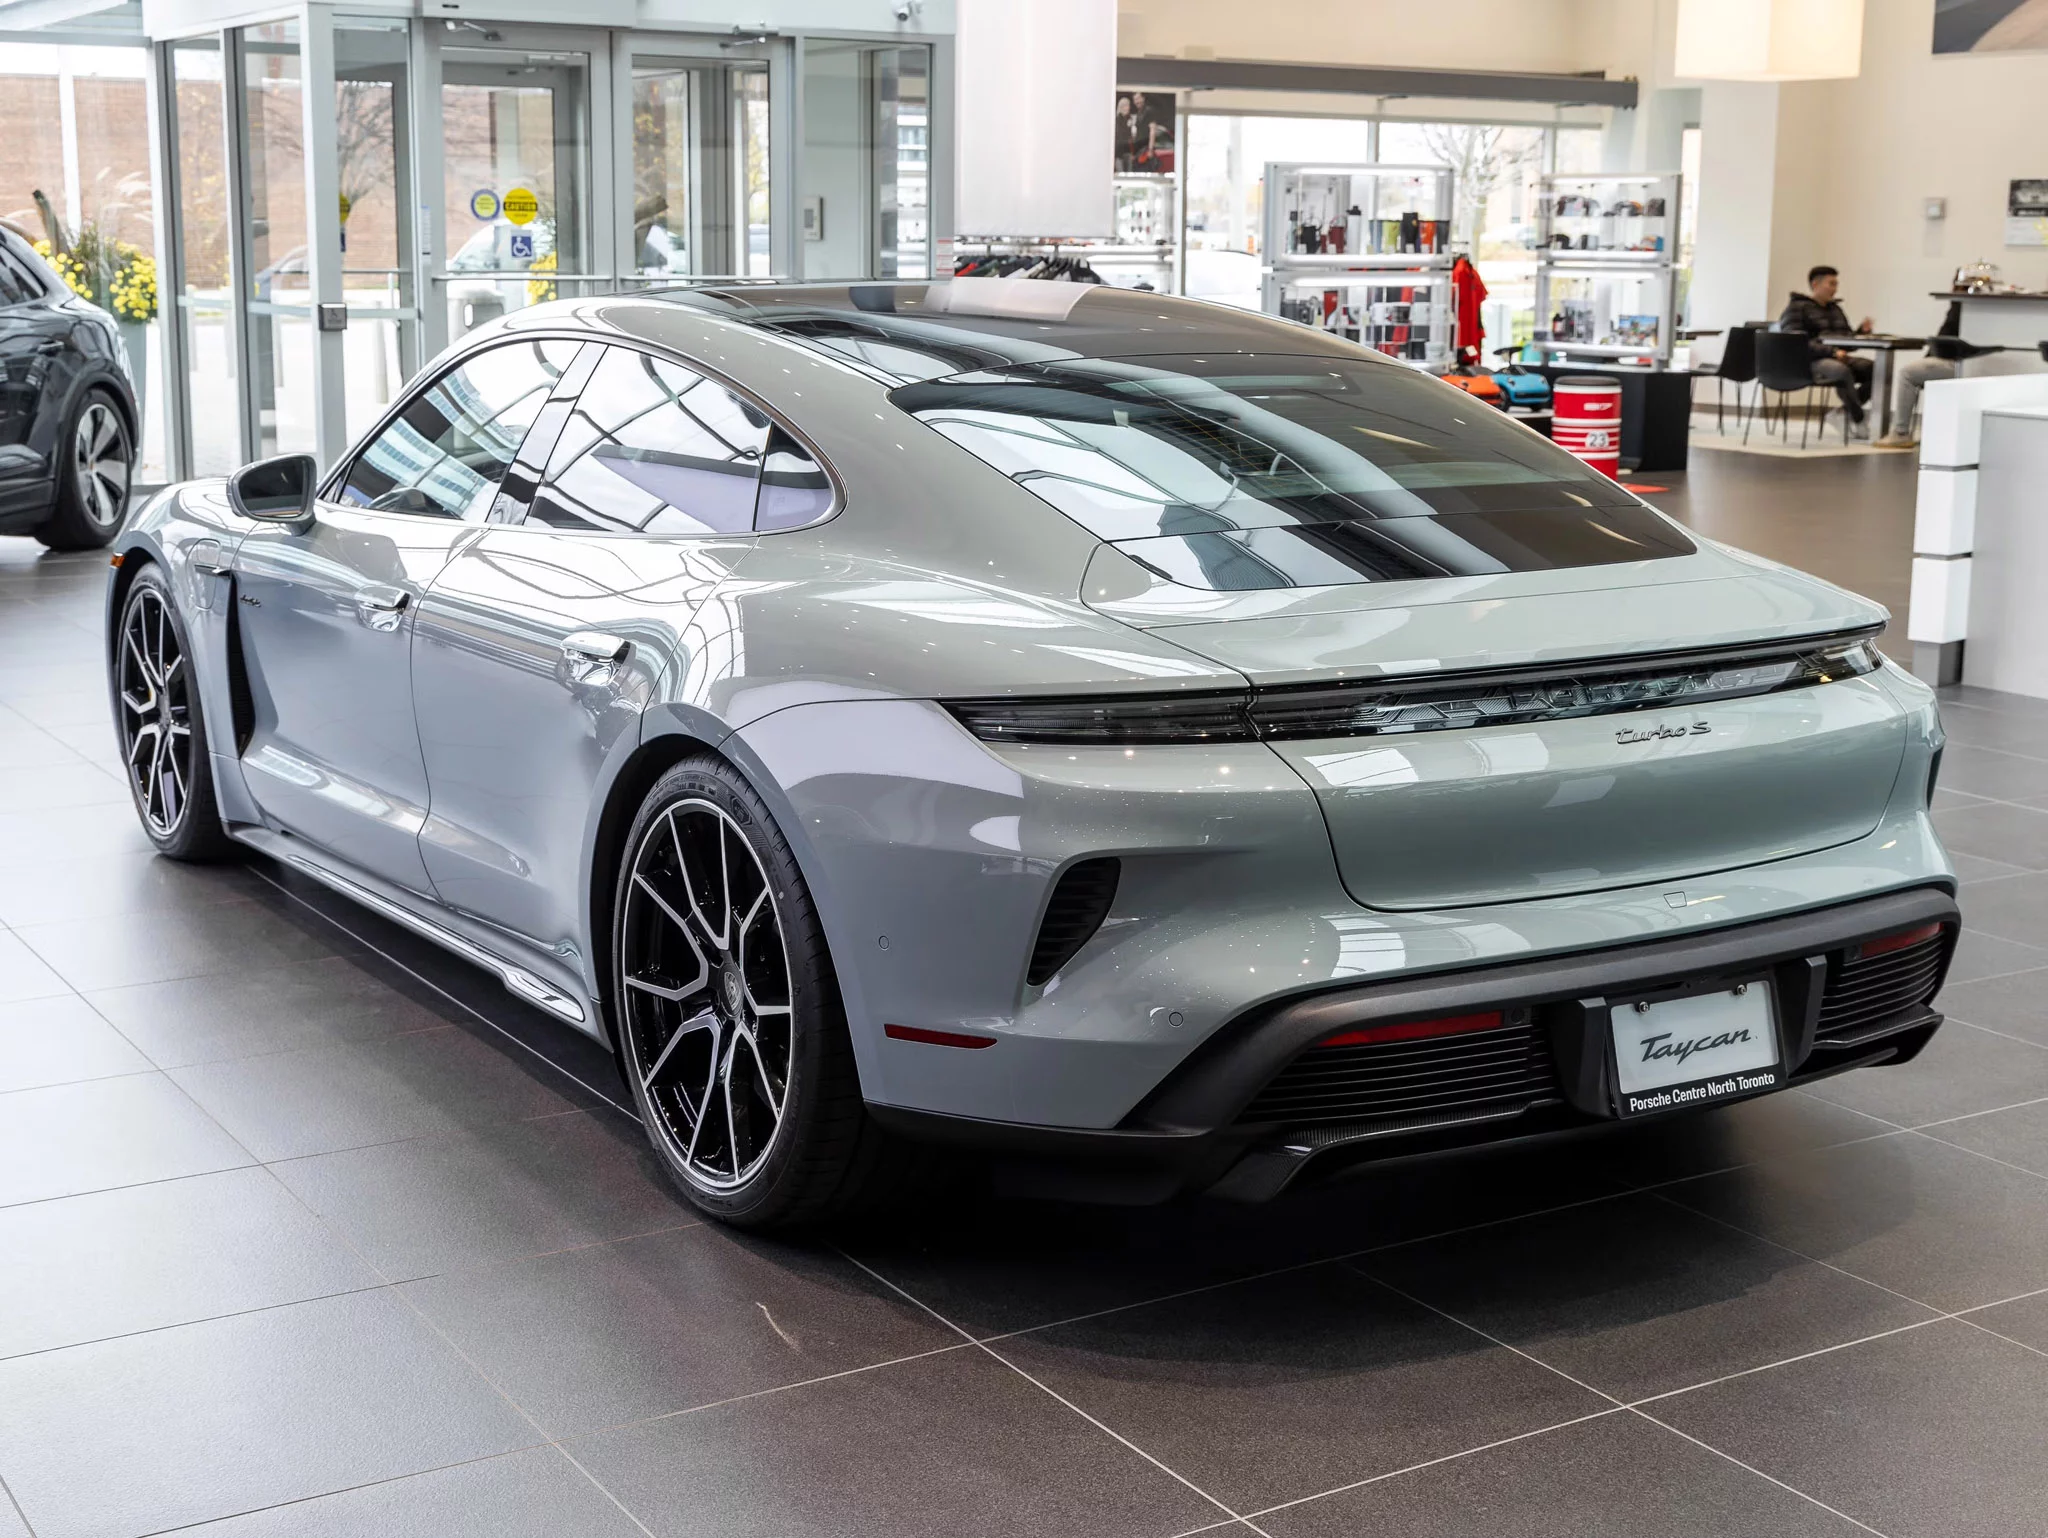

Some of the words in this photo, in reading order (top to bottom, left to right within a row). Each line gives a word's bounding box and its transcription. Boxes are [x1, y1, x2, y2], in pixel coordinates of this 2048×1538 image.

[1589, 433, 1606, 447] 23
[1689, 721, 1712, 736] S
[1640, 1028, 1751, 1066] Taycan
[1629, 1092, 1671, 1112] Porsche
[1672, 1086, 1707, 1103] Centre
[1707, 1078, 1737, 1097] North
[1736, 1073, 1775, 1090] Toronto
